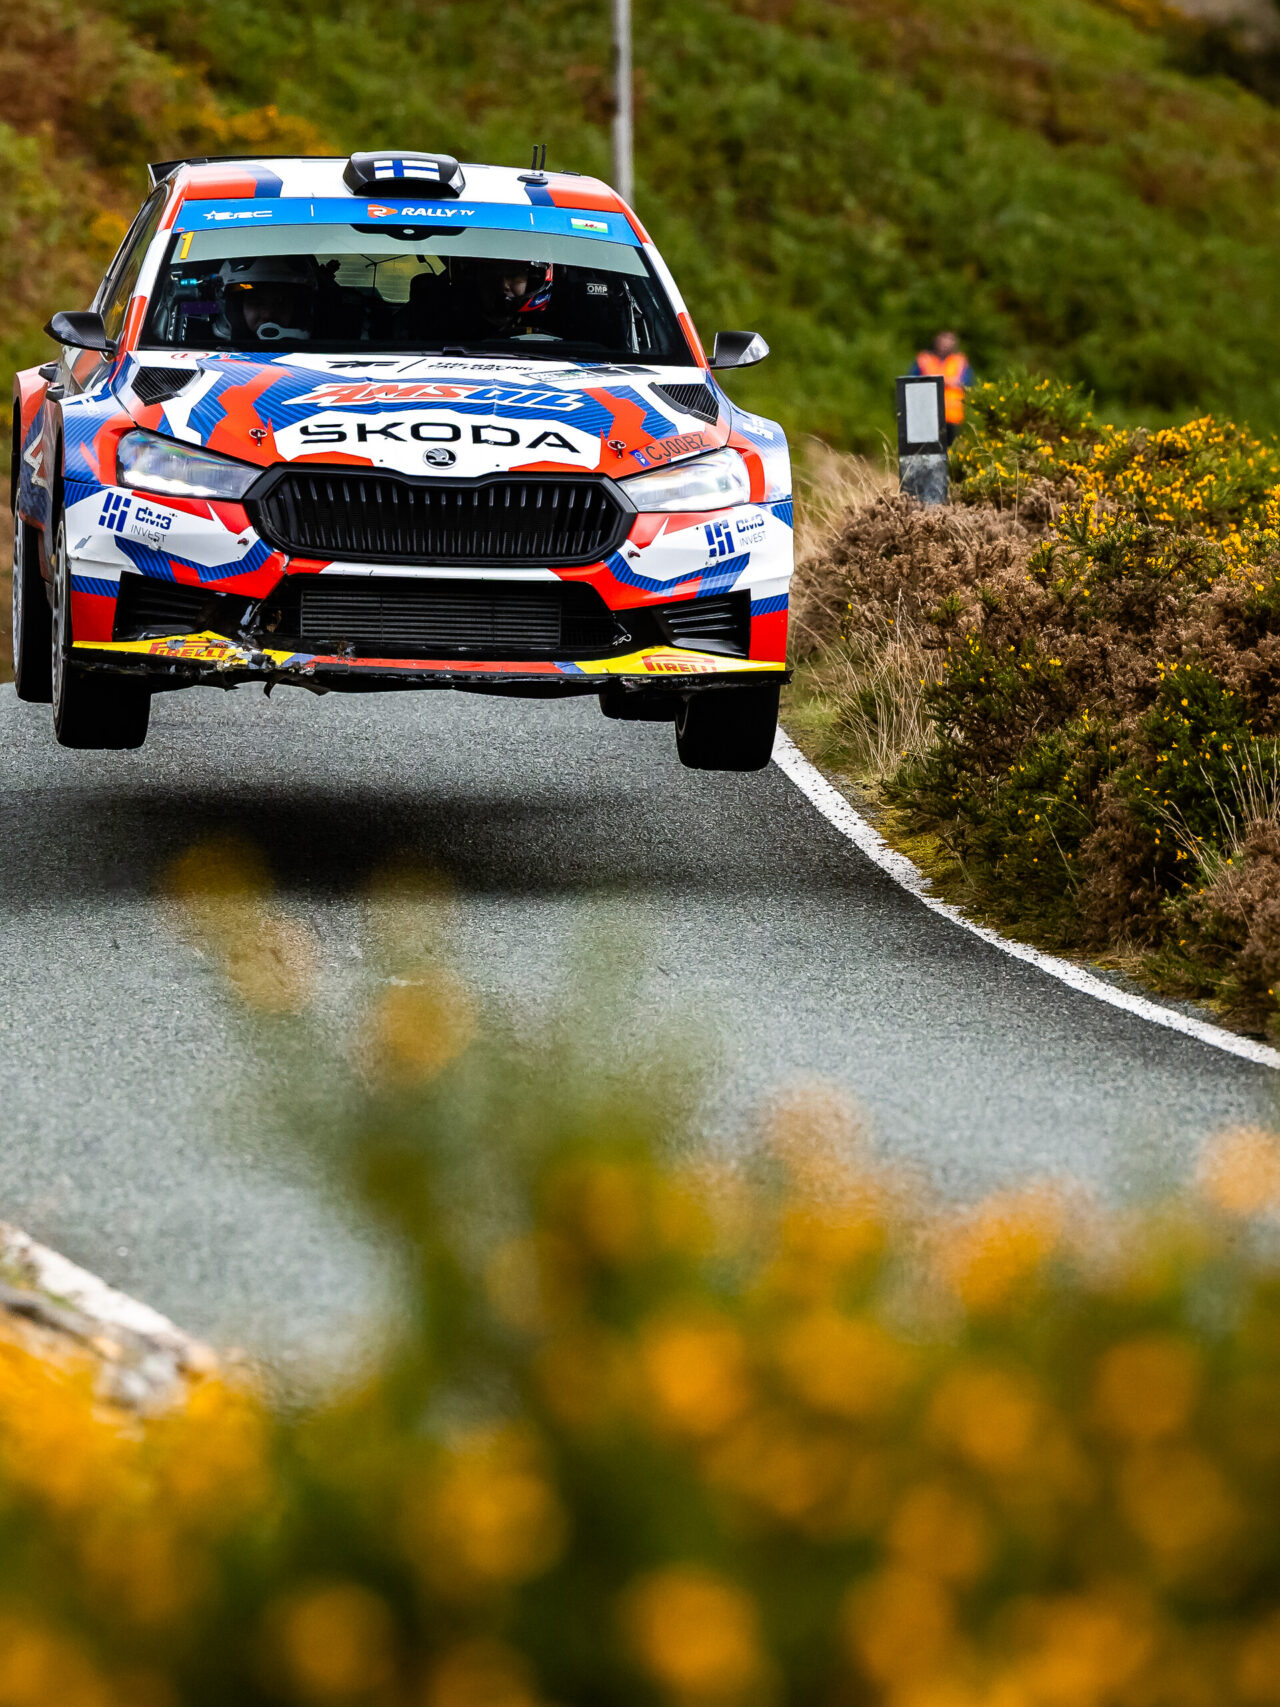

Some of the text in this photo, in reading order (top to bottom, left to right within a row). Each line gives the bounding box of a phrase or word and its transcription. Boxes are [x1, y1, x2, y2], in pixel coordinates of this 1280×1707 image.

[401, 207, 458, 217] RALLY
[179, 231, 195, 260] 1
[587, 285, 608, 294] OMP
[290, 383, 582, 411] AMSOIL
[130, 524, 167, 543] INVEST
[740, 530, 766, 547] INVEST
[148, 640, 227, 658] PIRELLI
[642, 654, 718, 673] PIRELLI
